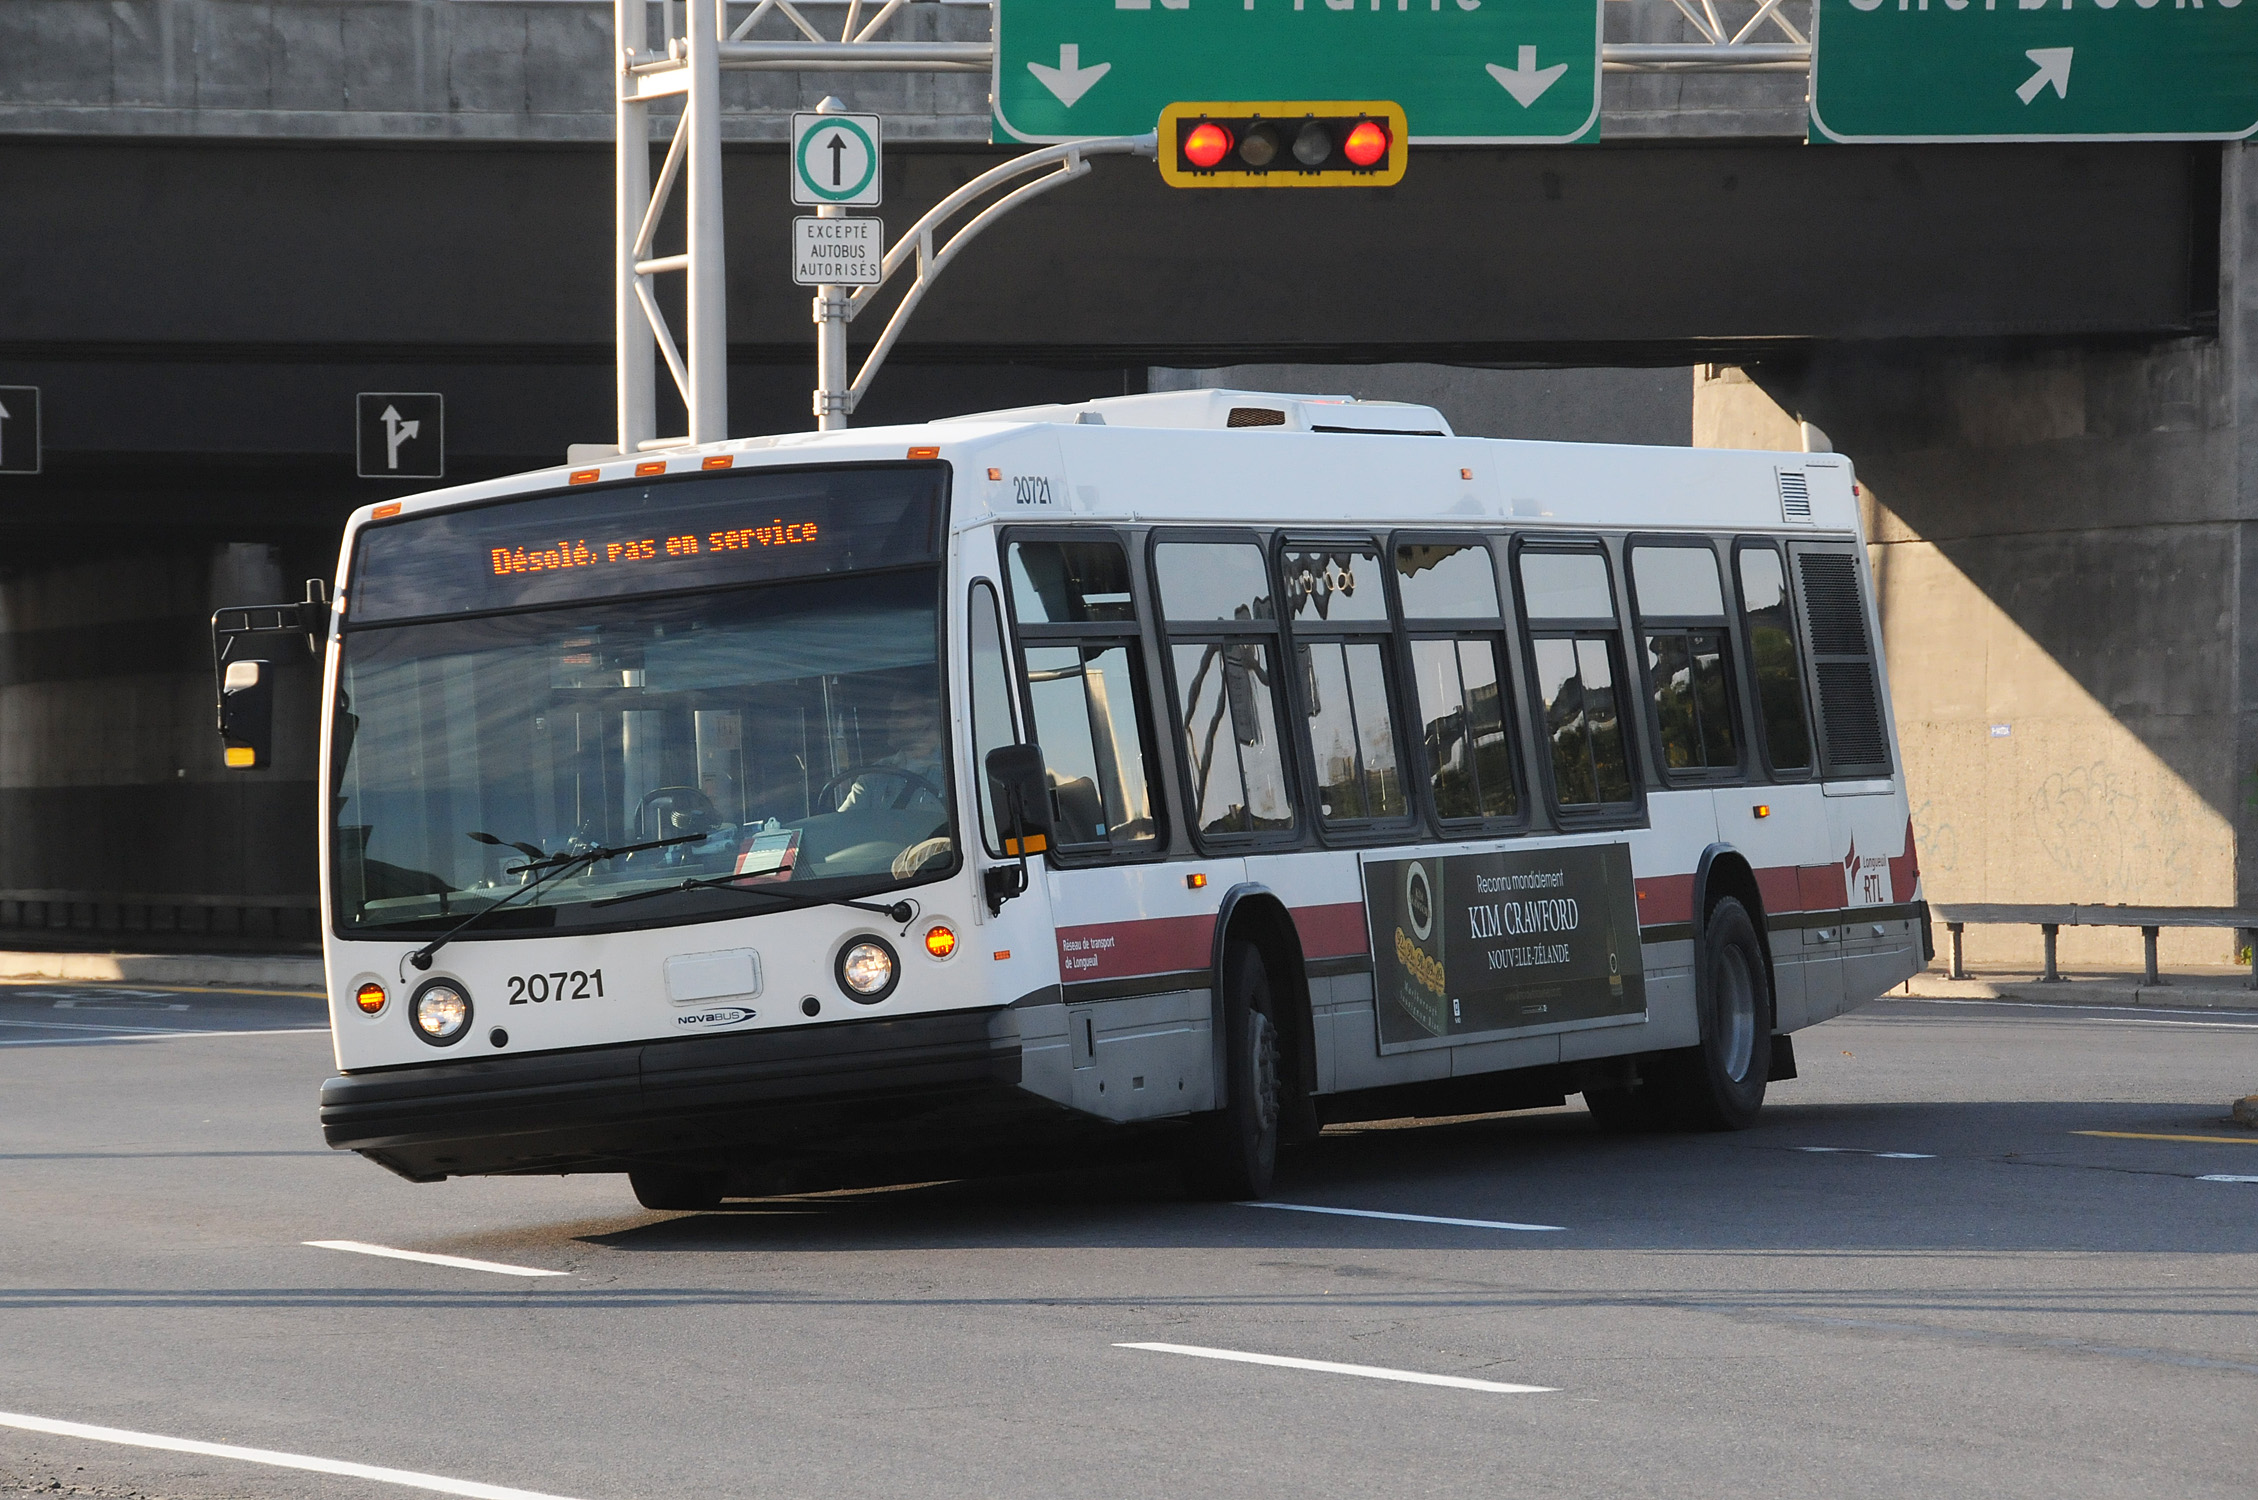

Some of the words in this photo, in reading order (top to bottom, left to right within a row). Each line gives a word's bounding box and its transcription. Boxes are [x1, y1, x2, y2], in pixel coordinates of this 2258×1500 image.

[807, 222, 868, 239] EXCEPTÉ
[811, 244, 866, 259] AUTOBUS
[800, 260, 877, 276] AUTORISÉS
[1013, 476, 1052, 505] 20721
[491, 539, 598, 575] Désolé,
[665, 534, 699, 556] en
[708, 519, 818, 552] service
[1476, 874, 1512, 894] Reconnu
[1512, 869, 1564, 890] mondialement
[1864, 874, 1884, 903] RTL
[1468, 904, 1502, 939] KIM
[1504, 898, 1579, 935] CRAWFORD
[1062, 938, 1082, 952] Réseau
[1082, 937, 1090, 950] de
[1090, 936, 1115, 951] transport
[1488, 942, 1570, 970] NOUVELLE-ZÉLANDE
[1065, 956, 1073, 969] de
[1073, 953, 1099, 971] Longueuil
[507, 968, 604, 1006] 20721
